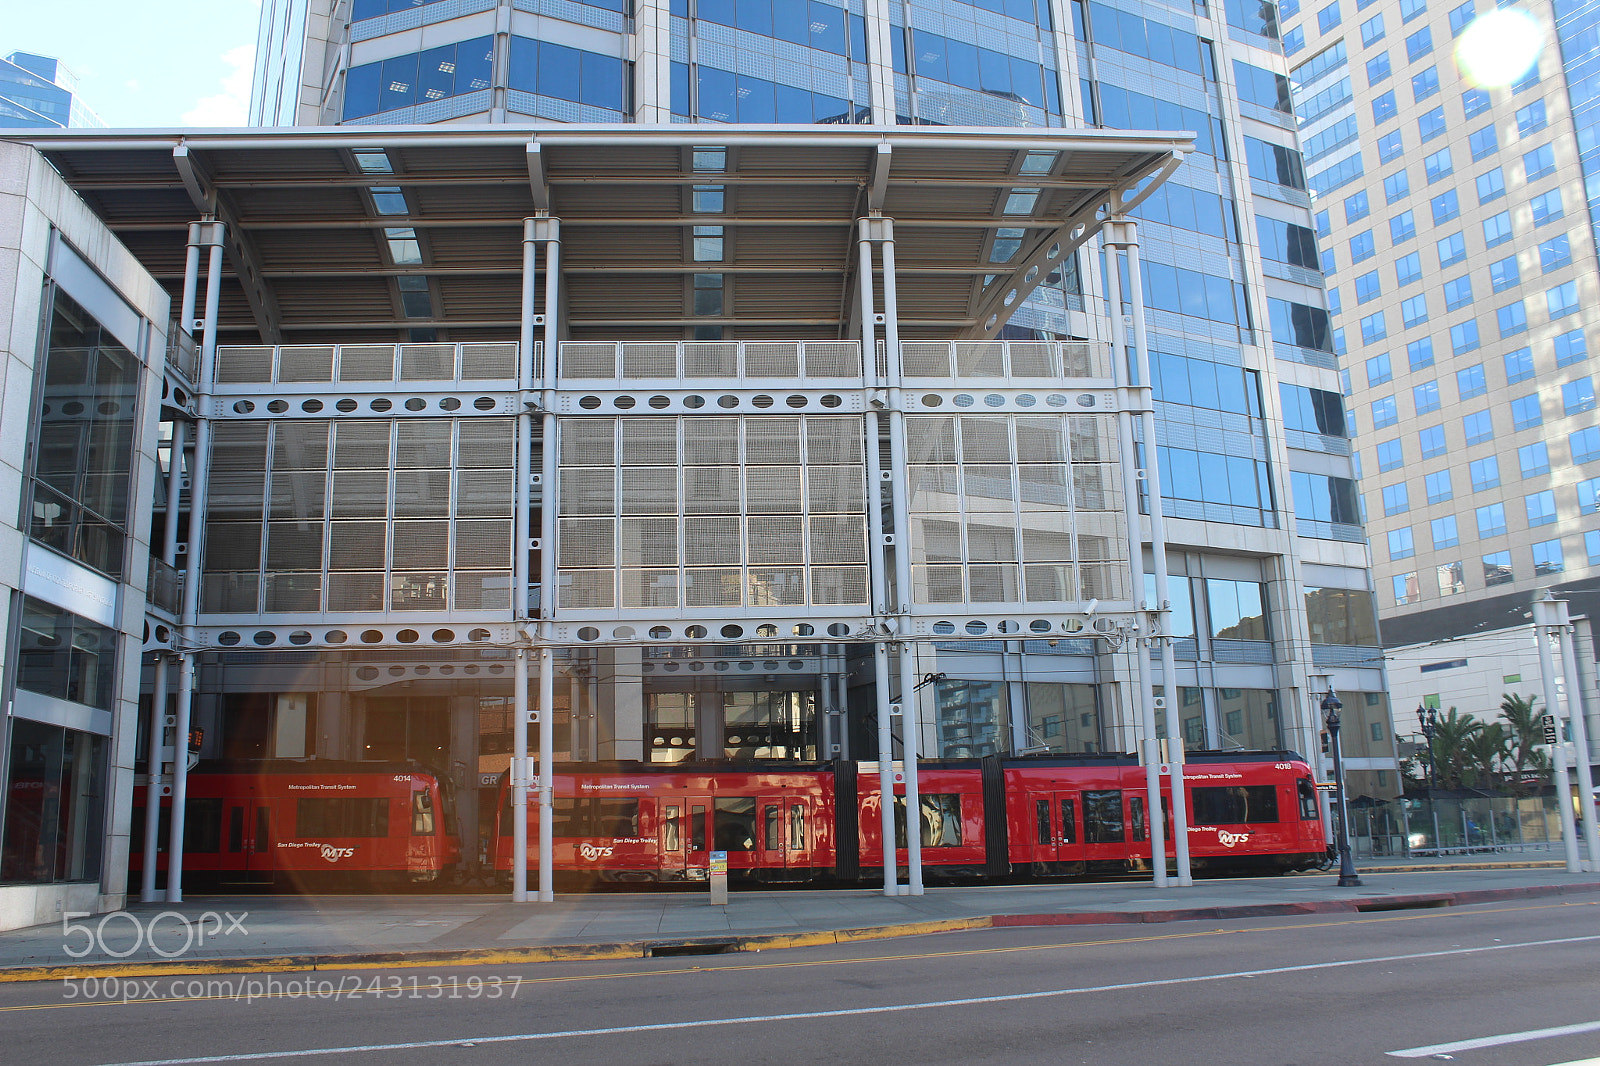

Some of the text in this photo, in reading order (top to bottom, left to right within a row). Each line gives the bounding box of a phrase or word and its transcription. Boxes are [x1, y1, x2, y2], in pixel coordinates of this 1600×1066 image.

[1219, 833, 1249, 843] MTS
[320, 847, 354, 858] MTS
[580, 846, 614, 857] MTS
